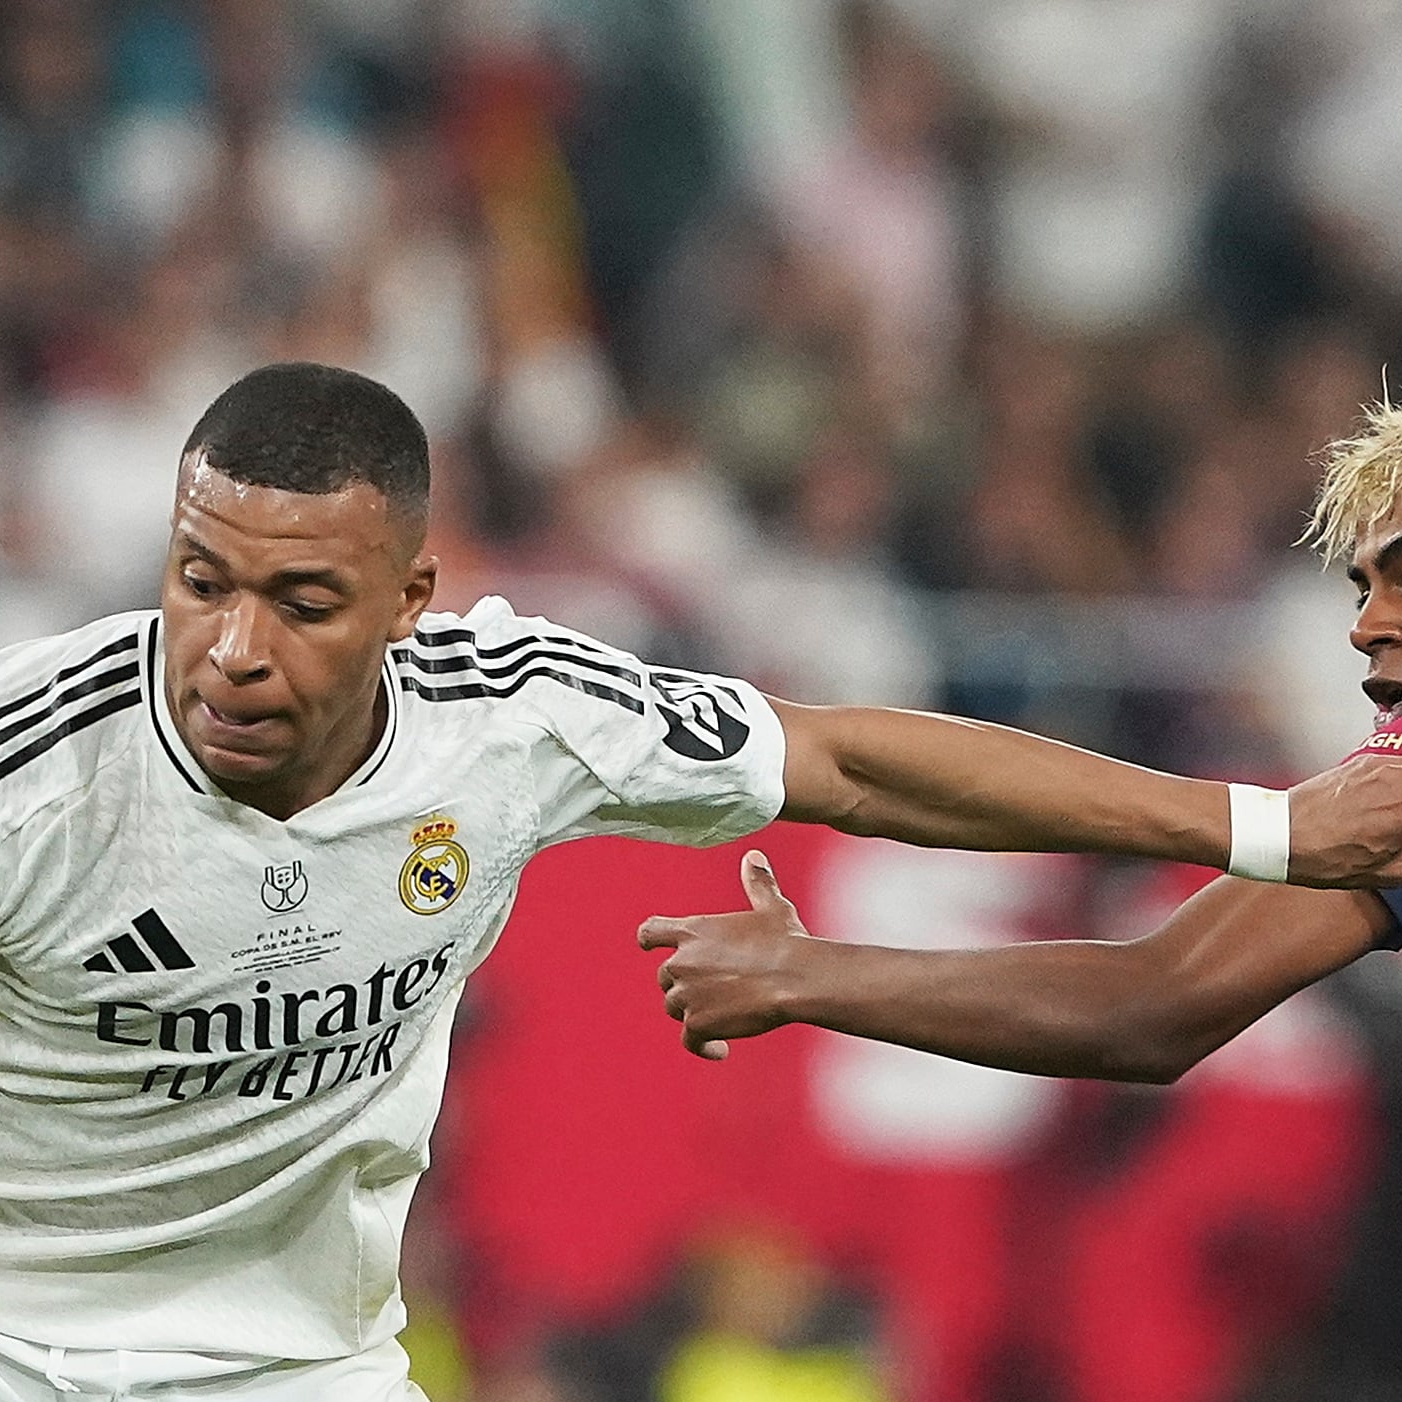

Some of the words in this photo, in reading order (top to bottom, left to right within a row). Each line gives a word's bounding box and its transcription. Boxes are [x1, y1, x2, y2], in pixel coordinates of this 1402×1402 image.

[231, 946, 260, 959] COPA
[263, 943, 278, 952] DE
[305, 936, 319, 944] EL
[321, 929, 343, 940] REY
[256, 924, 317, 942] FINAL
[96, 941, 456, 1054] Emirates
[139, 1061, 231, 1101] FLY
[237, 1021, 402, 1101] BETTER
